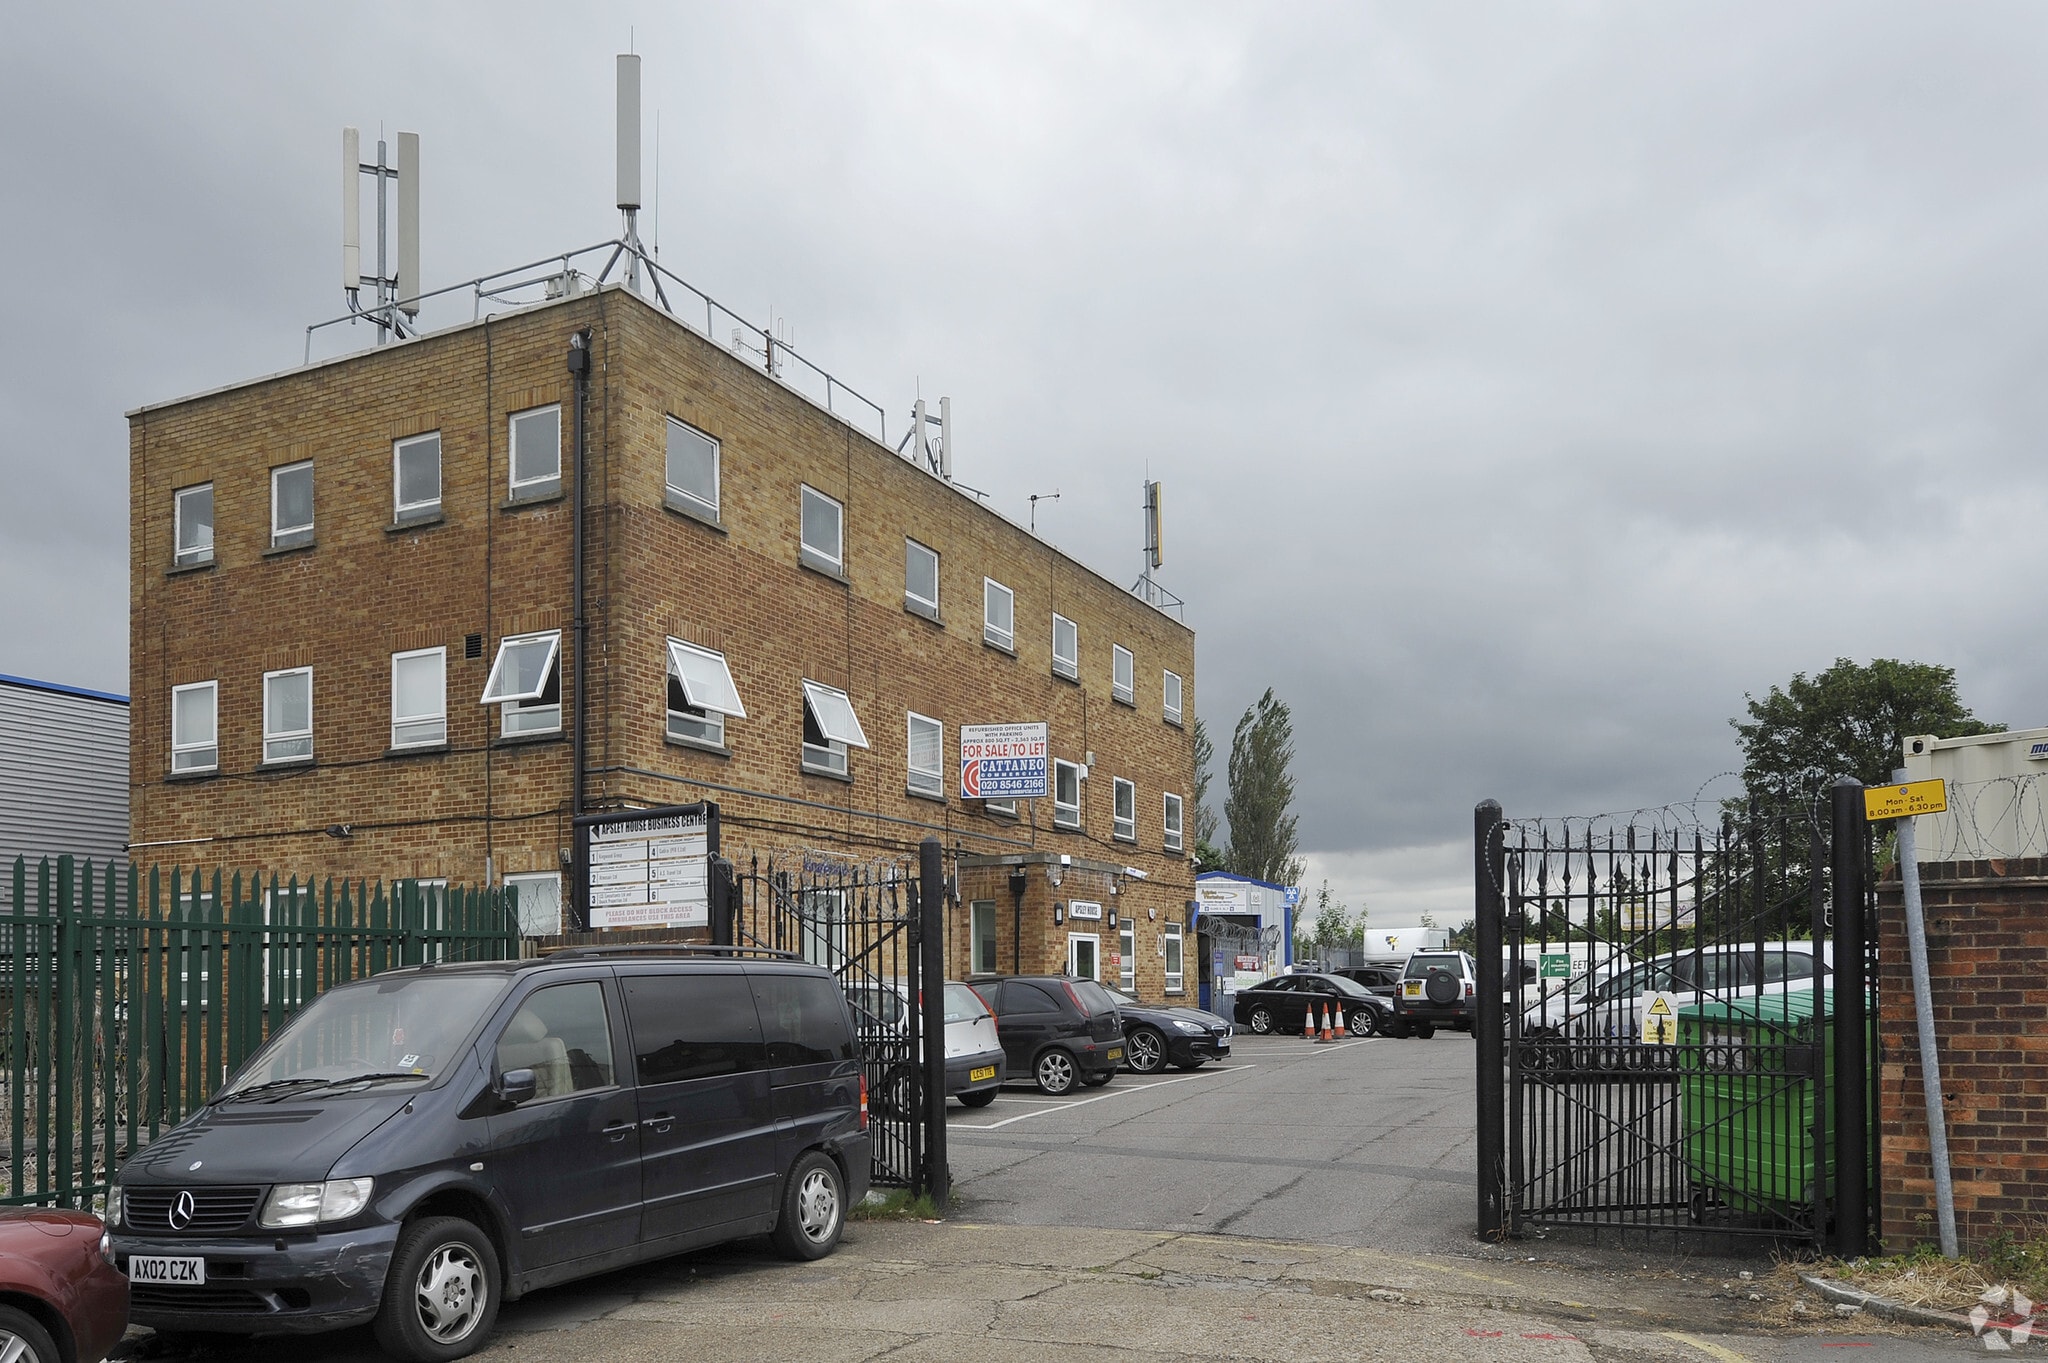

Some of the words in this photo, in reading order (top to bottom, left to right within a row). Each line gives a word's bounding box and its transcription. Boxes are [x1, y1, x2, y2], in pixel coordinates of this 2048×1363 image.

[962, 745, 983, 758] FOR
[1029, 742, 1045, 756] LET
[980, 758, 1044, 772] CATTANEO
[981, 780, 998, 790] 020
[999, 779, 1022, 789] 8546
[1023, 779, 1044, 789] 2166
[1885, 798, 1904, 807] Mon
[1909, 795, 1924, 804] Sat
[1869, 808, 1889, 818] 8.00
[1908, 803, 1929, 812] 6.30
[601, 822, 624, 835] APSLEY
[625, 819, 647, 833] HOUSE
[648, 816, 680, 831] BUSINESS
[681, 814, 707, 828] CENTRE
[591, 853, 595, 862] 1
[651, 847, 656, 857] 4
[591, 874, 596, 883] 2
[651, 869, 656, 879] 5
[591, 895, 596, 904] 3
[651, 891, 656, 900] 6
[606, 909, 626, 917] PLEASE
[626, 908, 635, 916] DO
[648, 907, 669, 915] BLOCK
[669, 905, 693, 913] ACCESS
[1075, 904, 1087, 915] APSLEY
[1087, 905, 1098, 916] HOUSE
[608, 915, 647, 923] AMBULANCES
[134, 1259, 167, 1279] AX02
[170, 1260, 198, 1281] CZK
